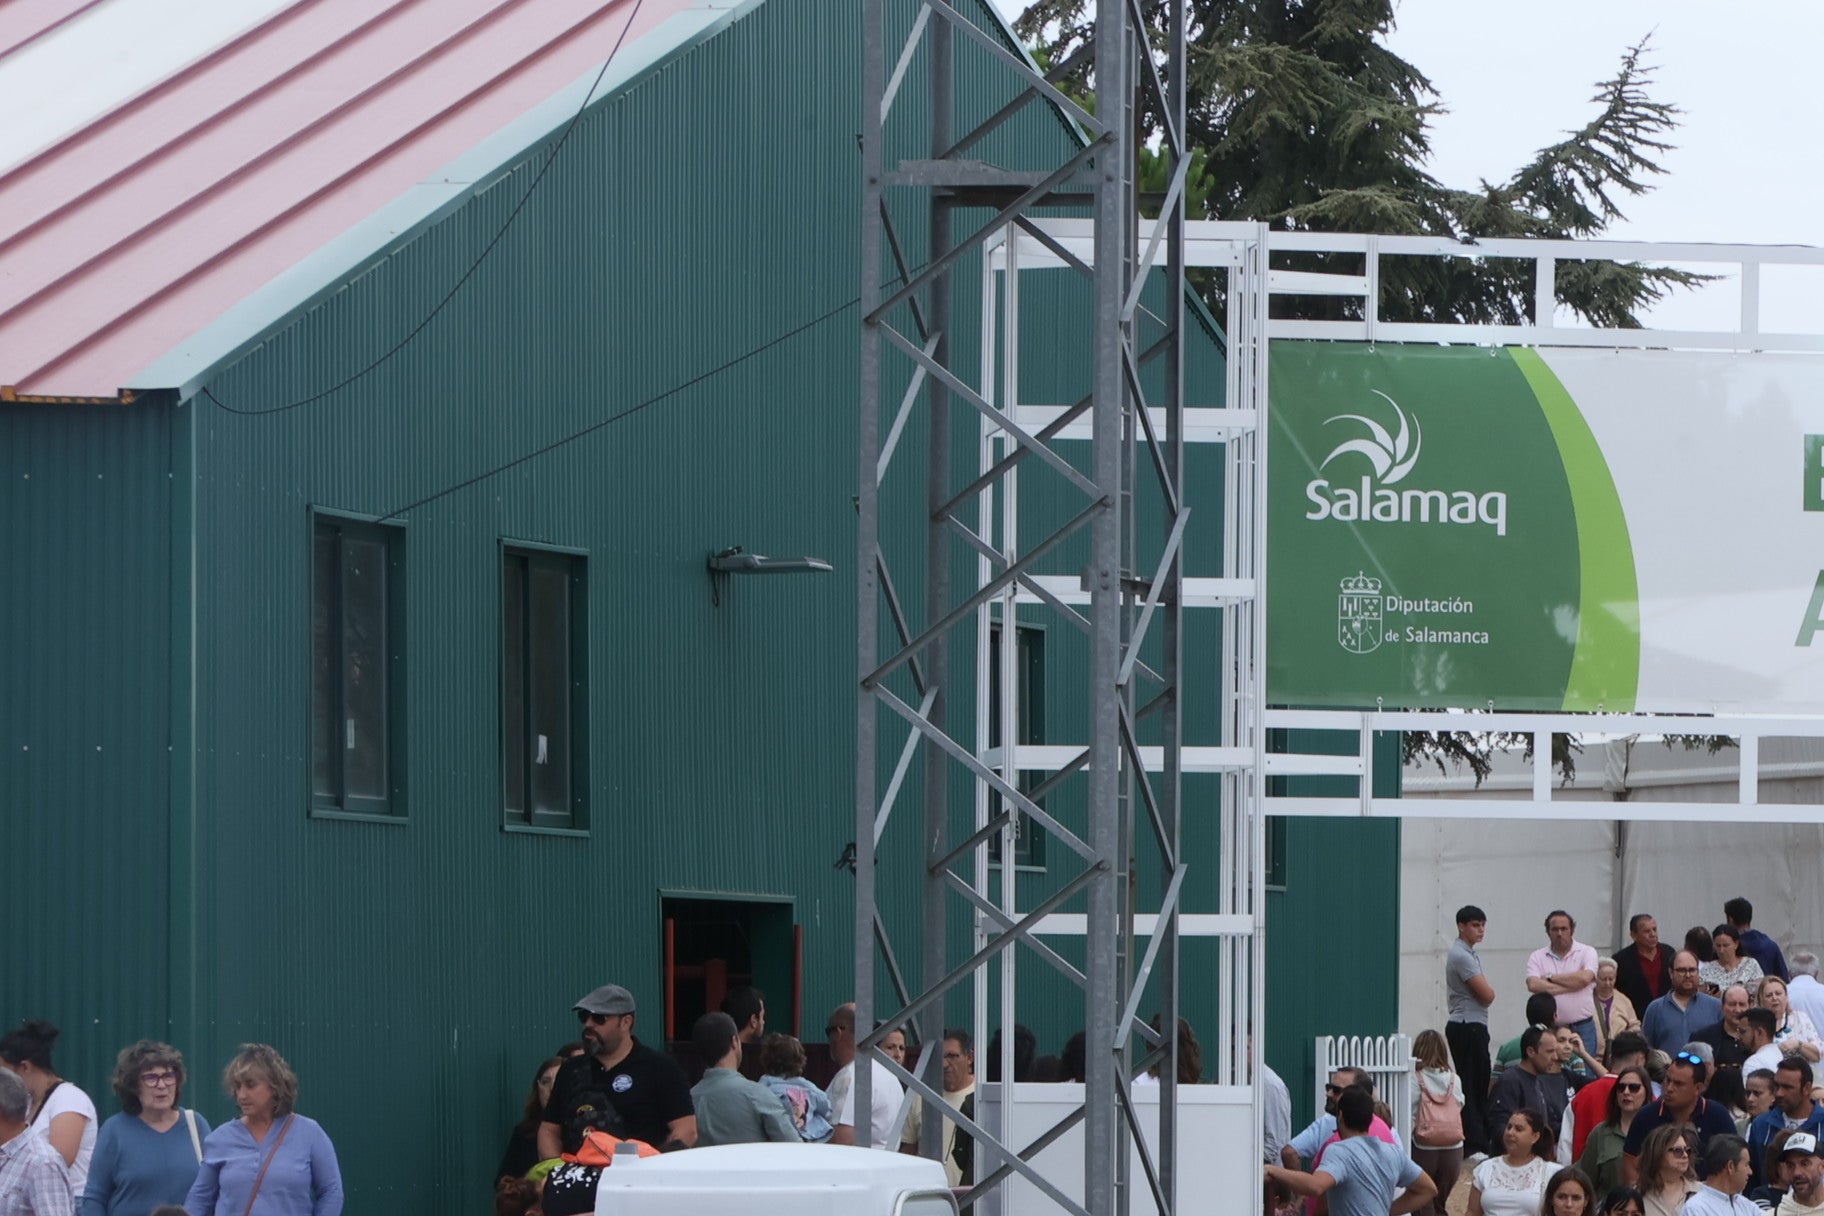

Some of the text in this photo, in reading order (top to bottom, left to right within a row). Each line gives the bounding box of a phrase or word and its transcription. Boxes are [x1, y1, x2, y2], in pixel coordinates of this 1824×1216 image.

[1305, 475, 1507, 536] Salamaq
[1386, 596, 1473, 615] Diputación
[1385, 626, 1489, 644] de Salamanca
